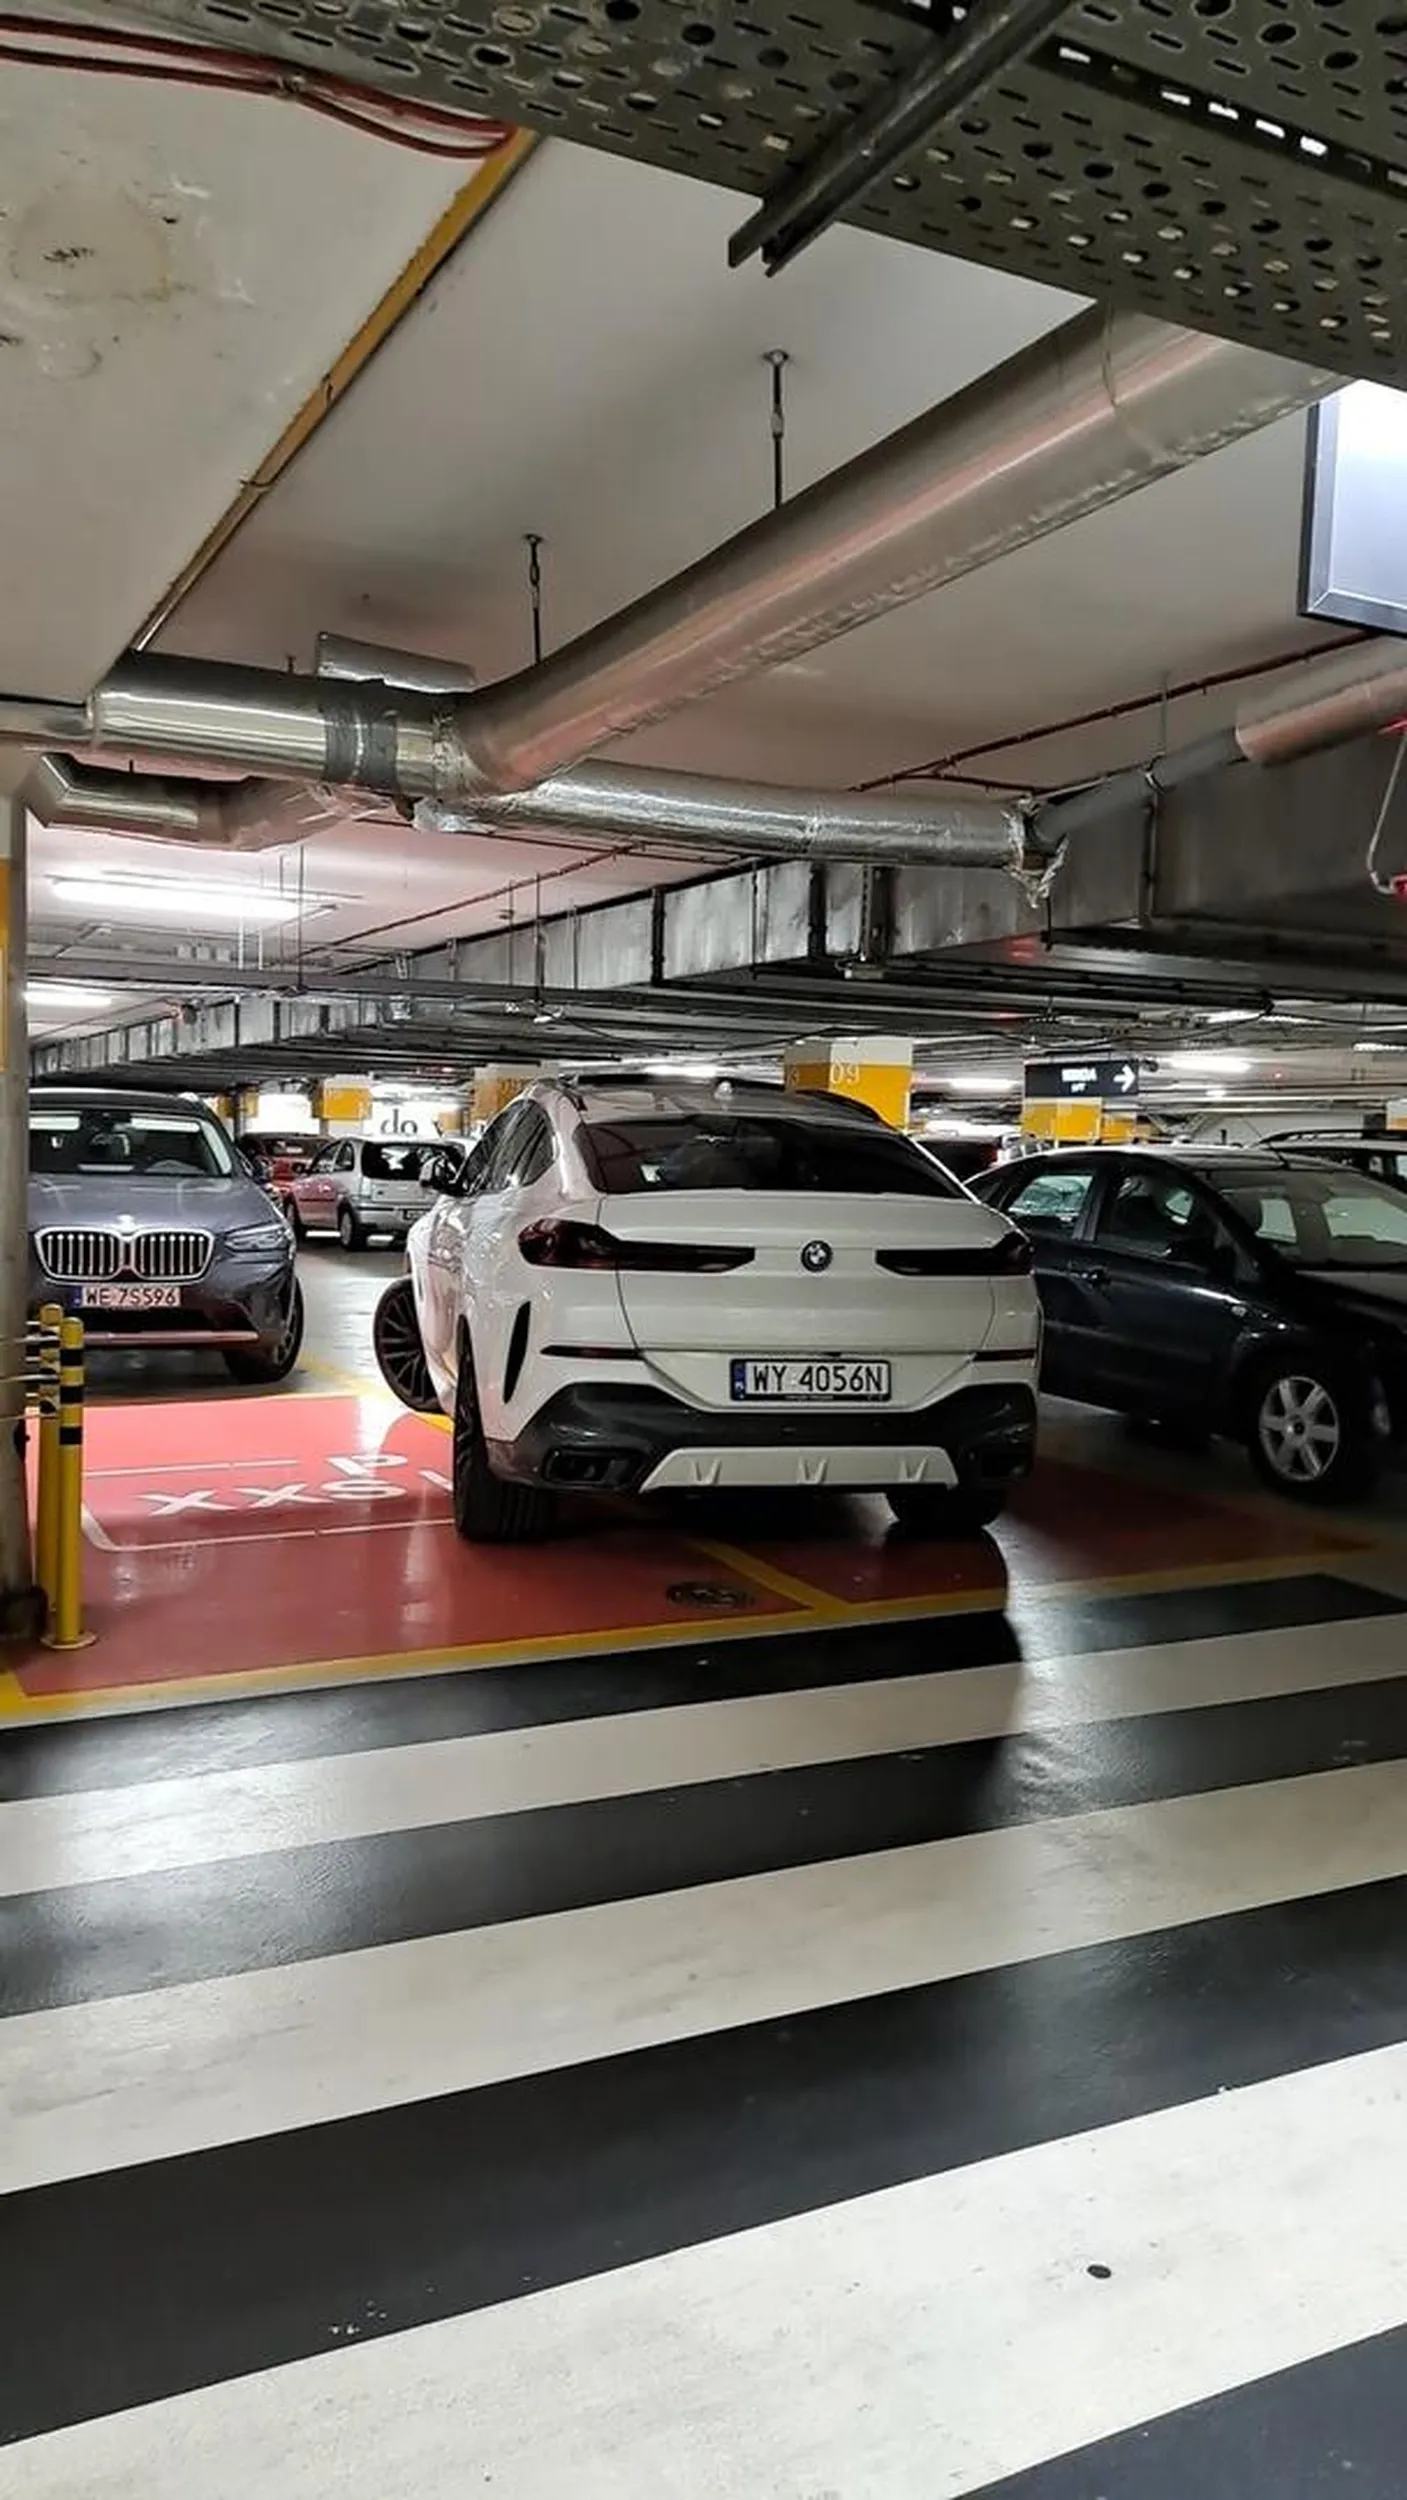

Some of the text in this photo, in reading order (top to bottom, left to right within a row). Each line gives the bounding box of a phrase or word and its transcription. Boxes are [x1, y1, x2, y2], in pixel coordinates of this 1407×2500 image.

[830, 1061, 860, 1085] 09
[380, 1109, 418, 1134] do
[86, 1287, 112, 1305] WE
[753, 1360, 883, 1392] WY 4056N
[326, 1453, 408, 1478] P
[138, 1479, 407, 1517] XXS
